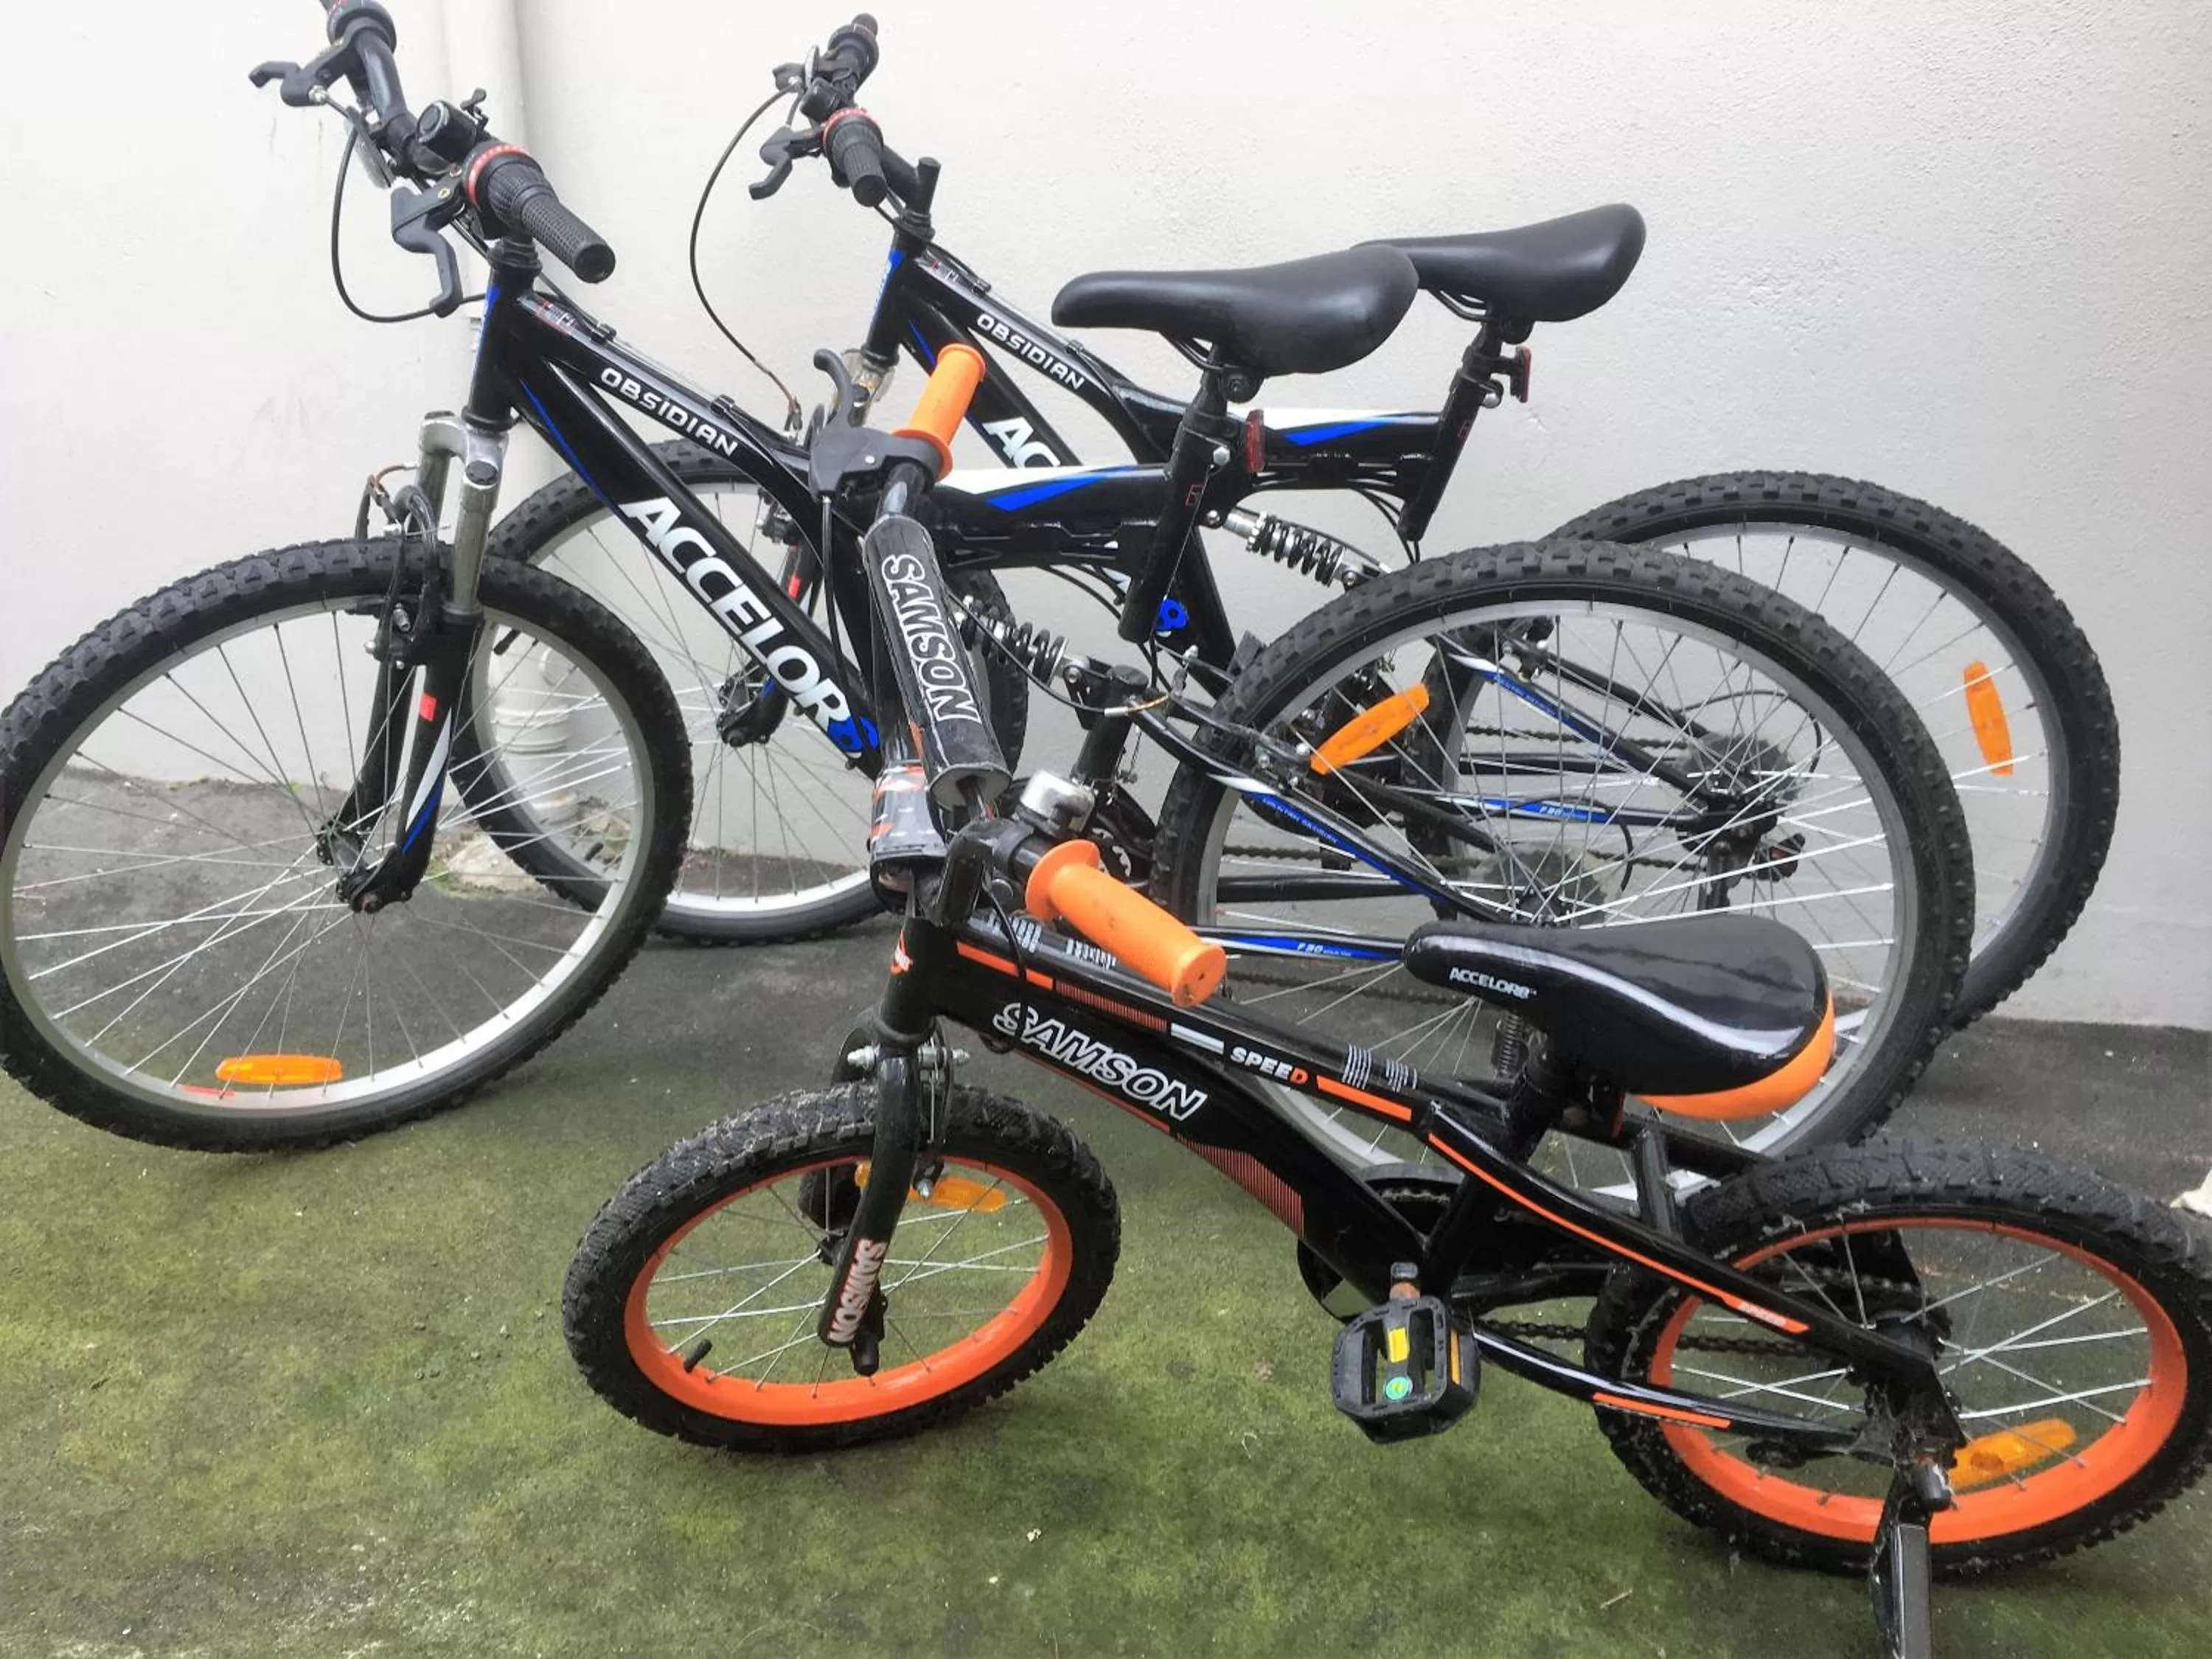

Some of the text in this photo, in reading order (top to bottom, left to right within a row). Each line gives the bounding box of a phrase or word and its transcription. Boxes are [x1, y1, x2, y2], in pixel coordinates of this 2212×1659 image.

[976, 311, 1085, 391] OBSIDIAN
[600, 366, 739, 457] OBSIDIAN
[881, 553, 982, 725] SAMSON
[992, 1002, 1207, 1121] SAMSON
[1230, 1046, 1310, 1085] SPEED
